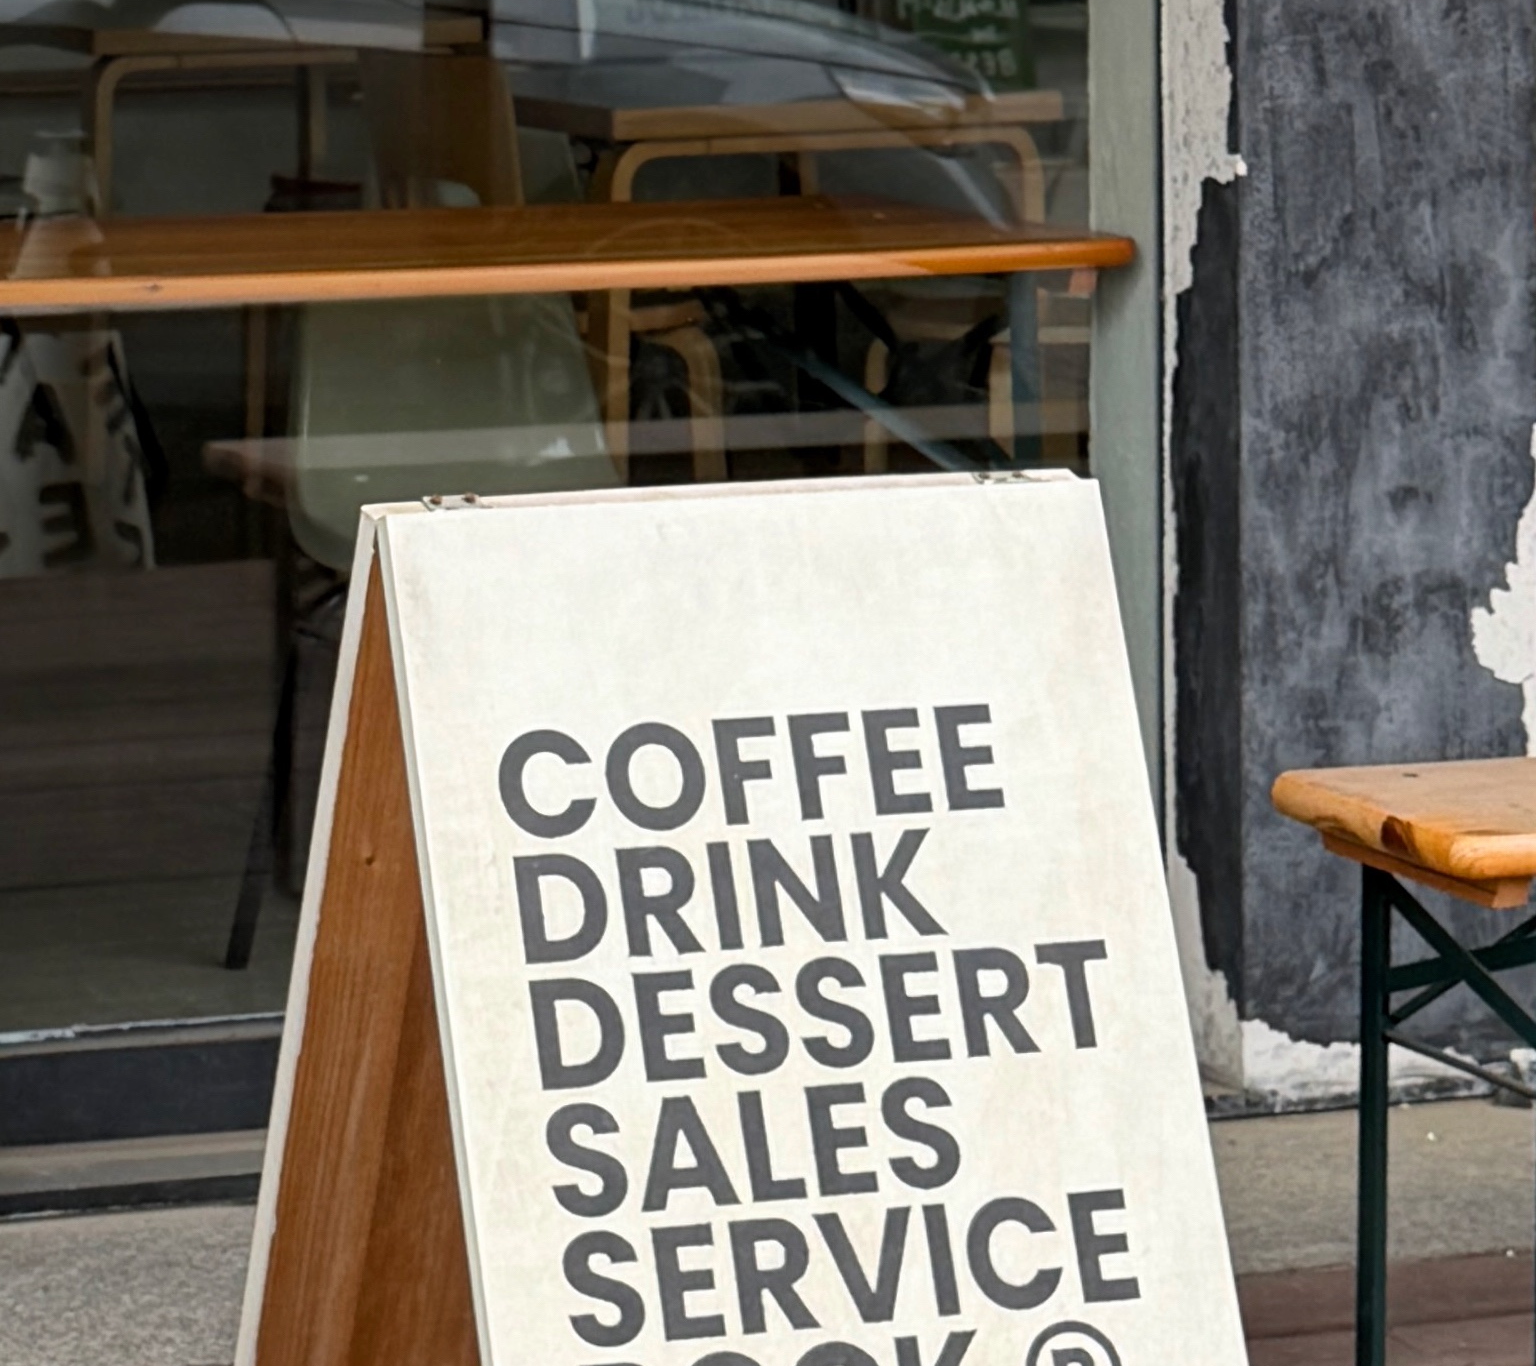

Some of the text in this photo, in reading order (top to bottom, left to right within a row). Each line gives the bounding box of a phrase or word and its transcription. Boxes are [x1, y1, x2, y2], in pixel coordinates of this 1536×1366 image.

[498, 704, 1005, 839] COFFEE
[513, 828, 948, 964] DRINK
[528, 939, 1108, 1091] DESSERT
[546, 1076, 961, 1218] SALES
[562, 1188, 1141, 1348] SERVICE
